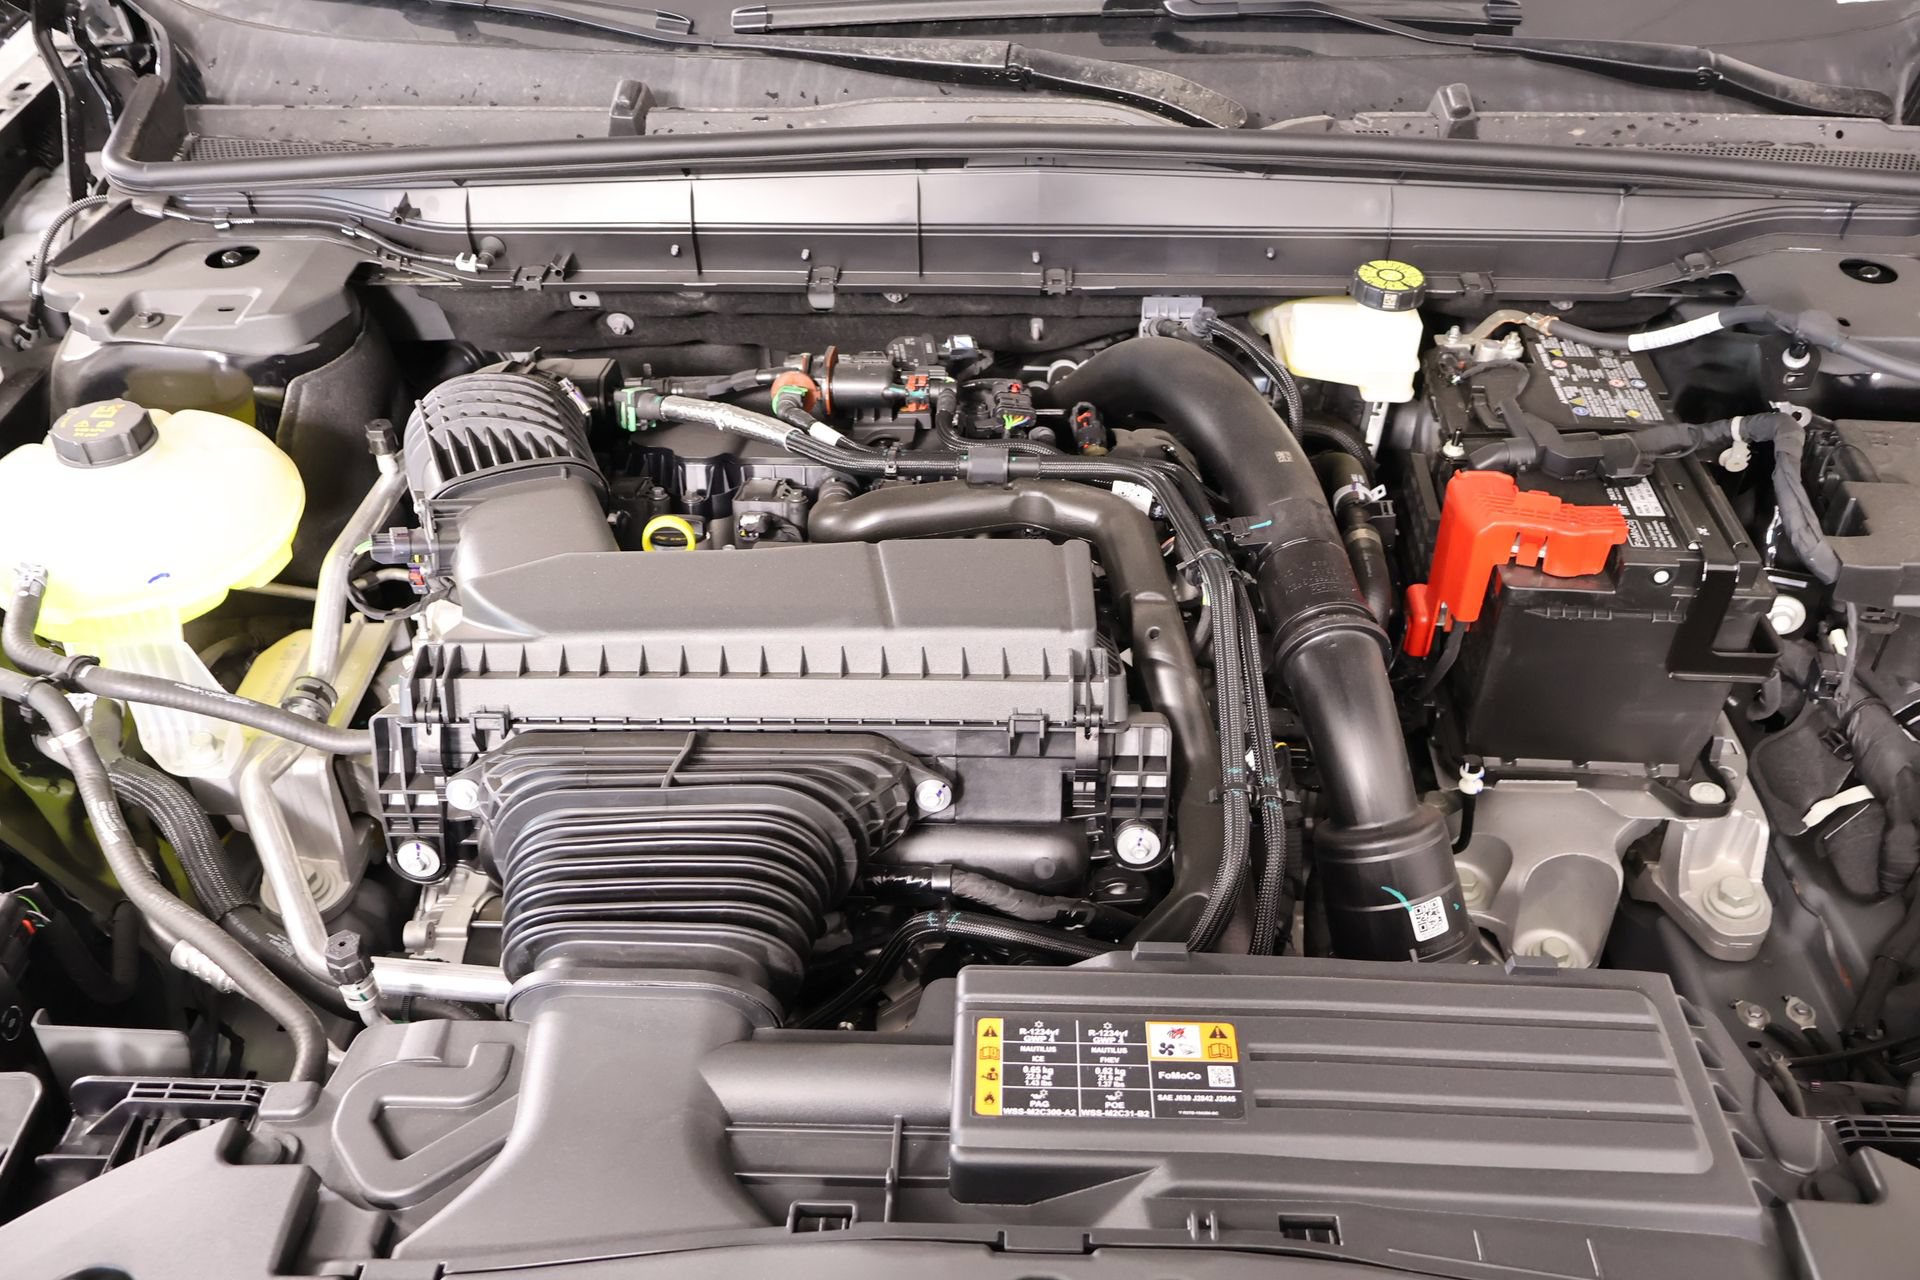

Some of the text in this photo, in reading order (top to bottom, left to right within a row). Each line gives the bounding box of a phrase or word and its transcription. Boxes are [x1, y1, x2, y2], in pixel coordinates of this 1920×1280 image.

[1019, 1028, 1059, 1037] R-1234yf
[1088, 1030, 1128, 1038] R-1234yf
[1093, 1036, 1116, 1044] GWP
[1042, 1066, 1054, 1076] kg
[1115, 1067, 1126, 1076] kg
[1158, 1071, 1202, 1080] FoMoCo
[1105, 1101, 1125, 1109] POE
